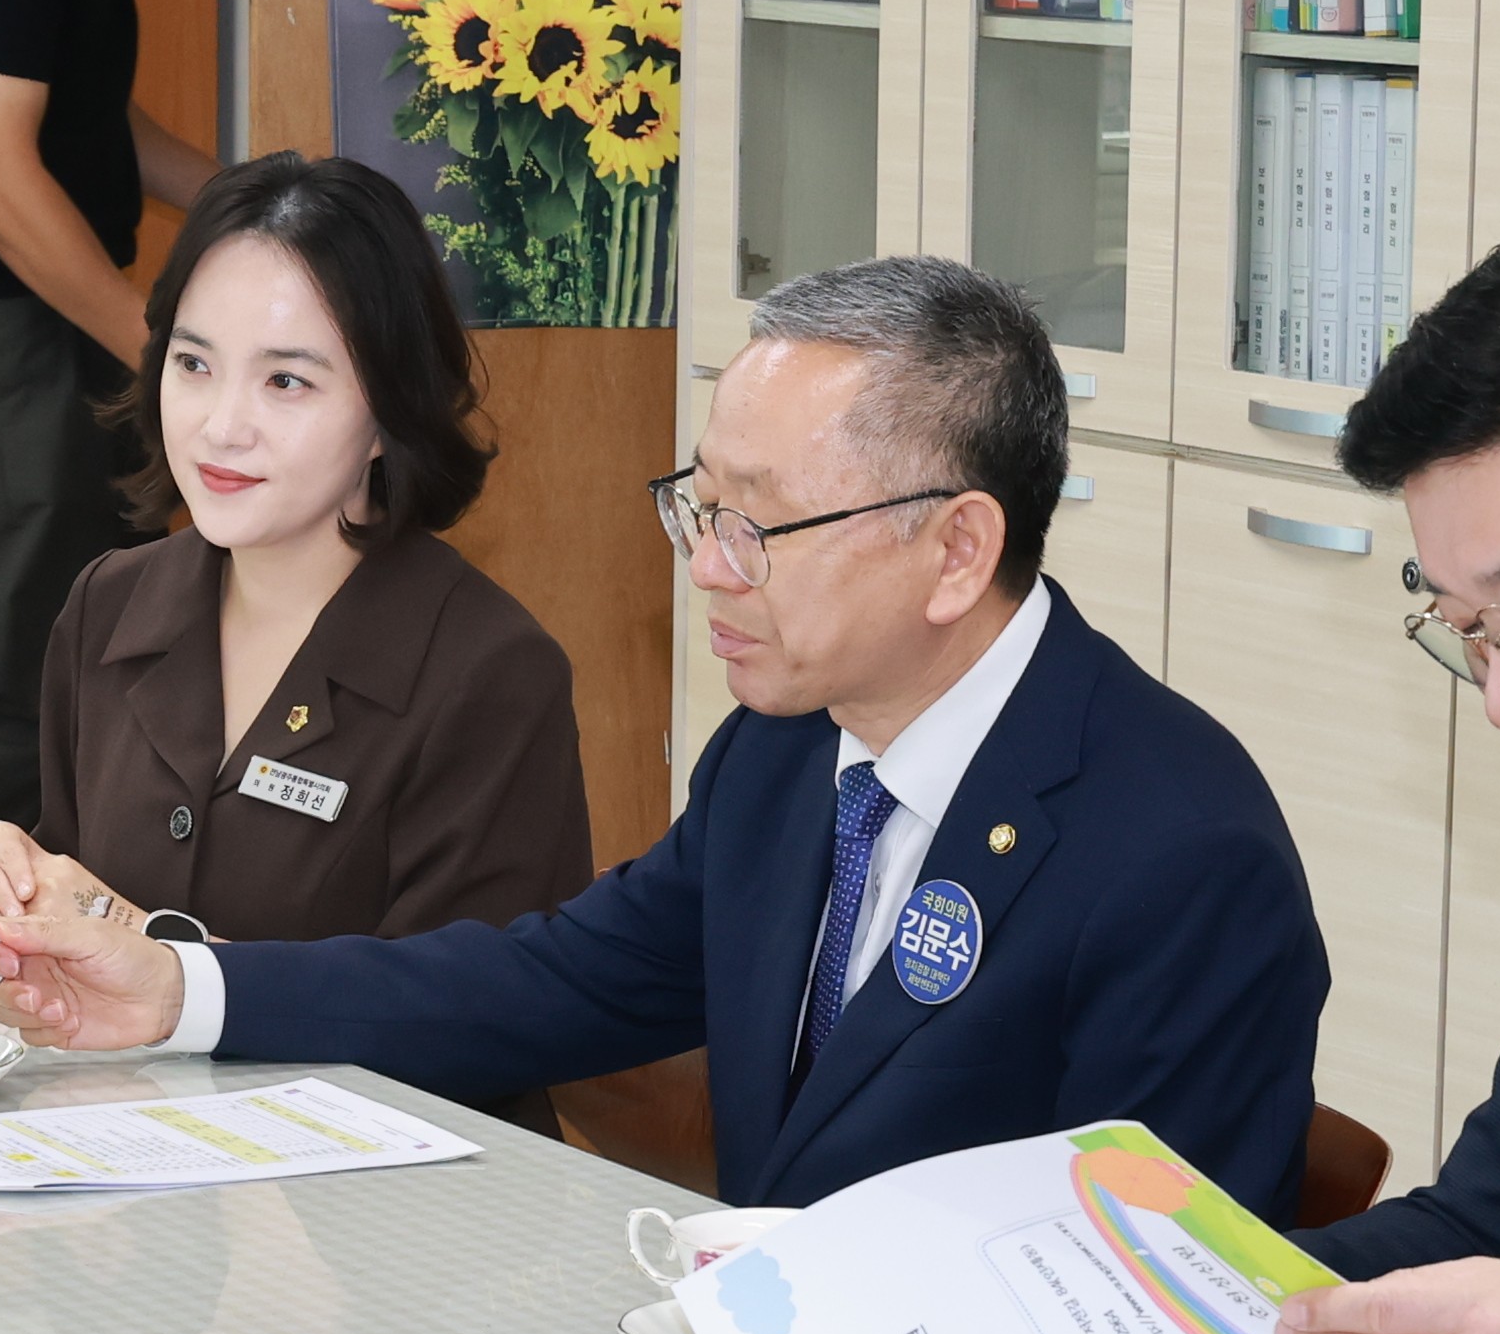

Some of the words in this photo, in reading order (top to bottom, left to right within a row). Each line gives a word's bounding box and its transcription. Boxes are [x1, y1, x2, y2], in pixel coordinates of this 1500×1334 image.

[280, 784, 326, 811] 정희선
[922, 889, 969, 924] 국회의원
[899, 907, 972, 971] 김문수
[1064, 1298, 1094, 1334] 저전길
